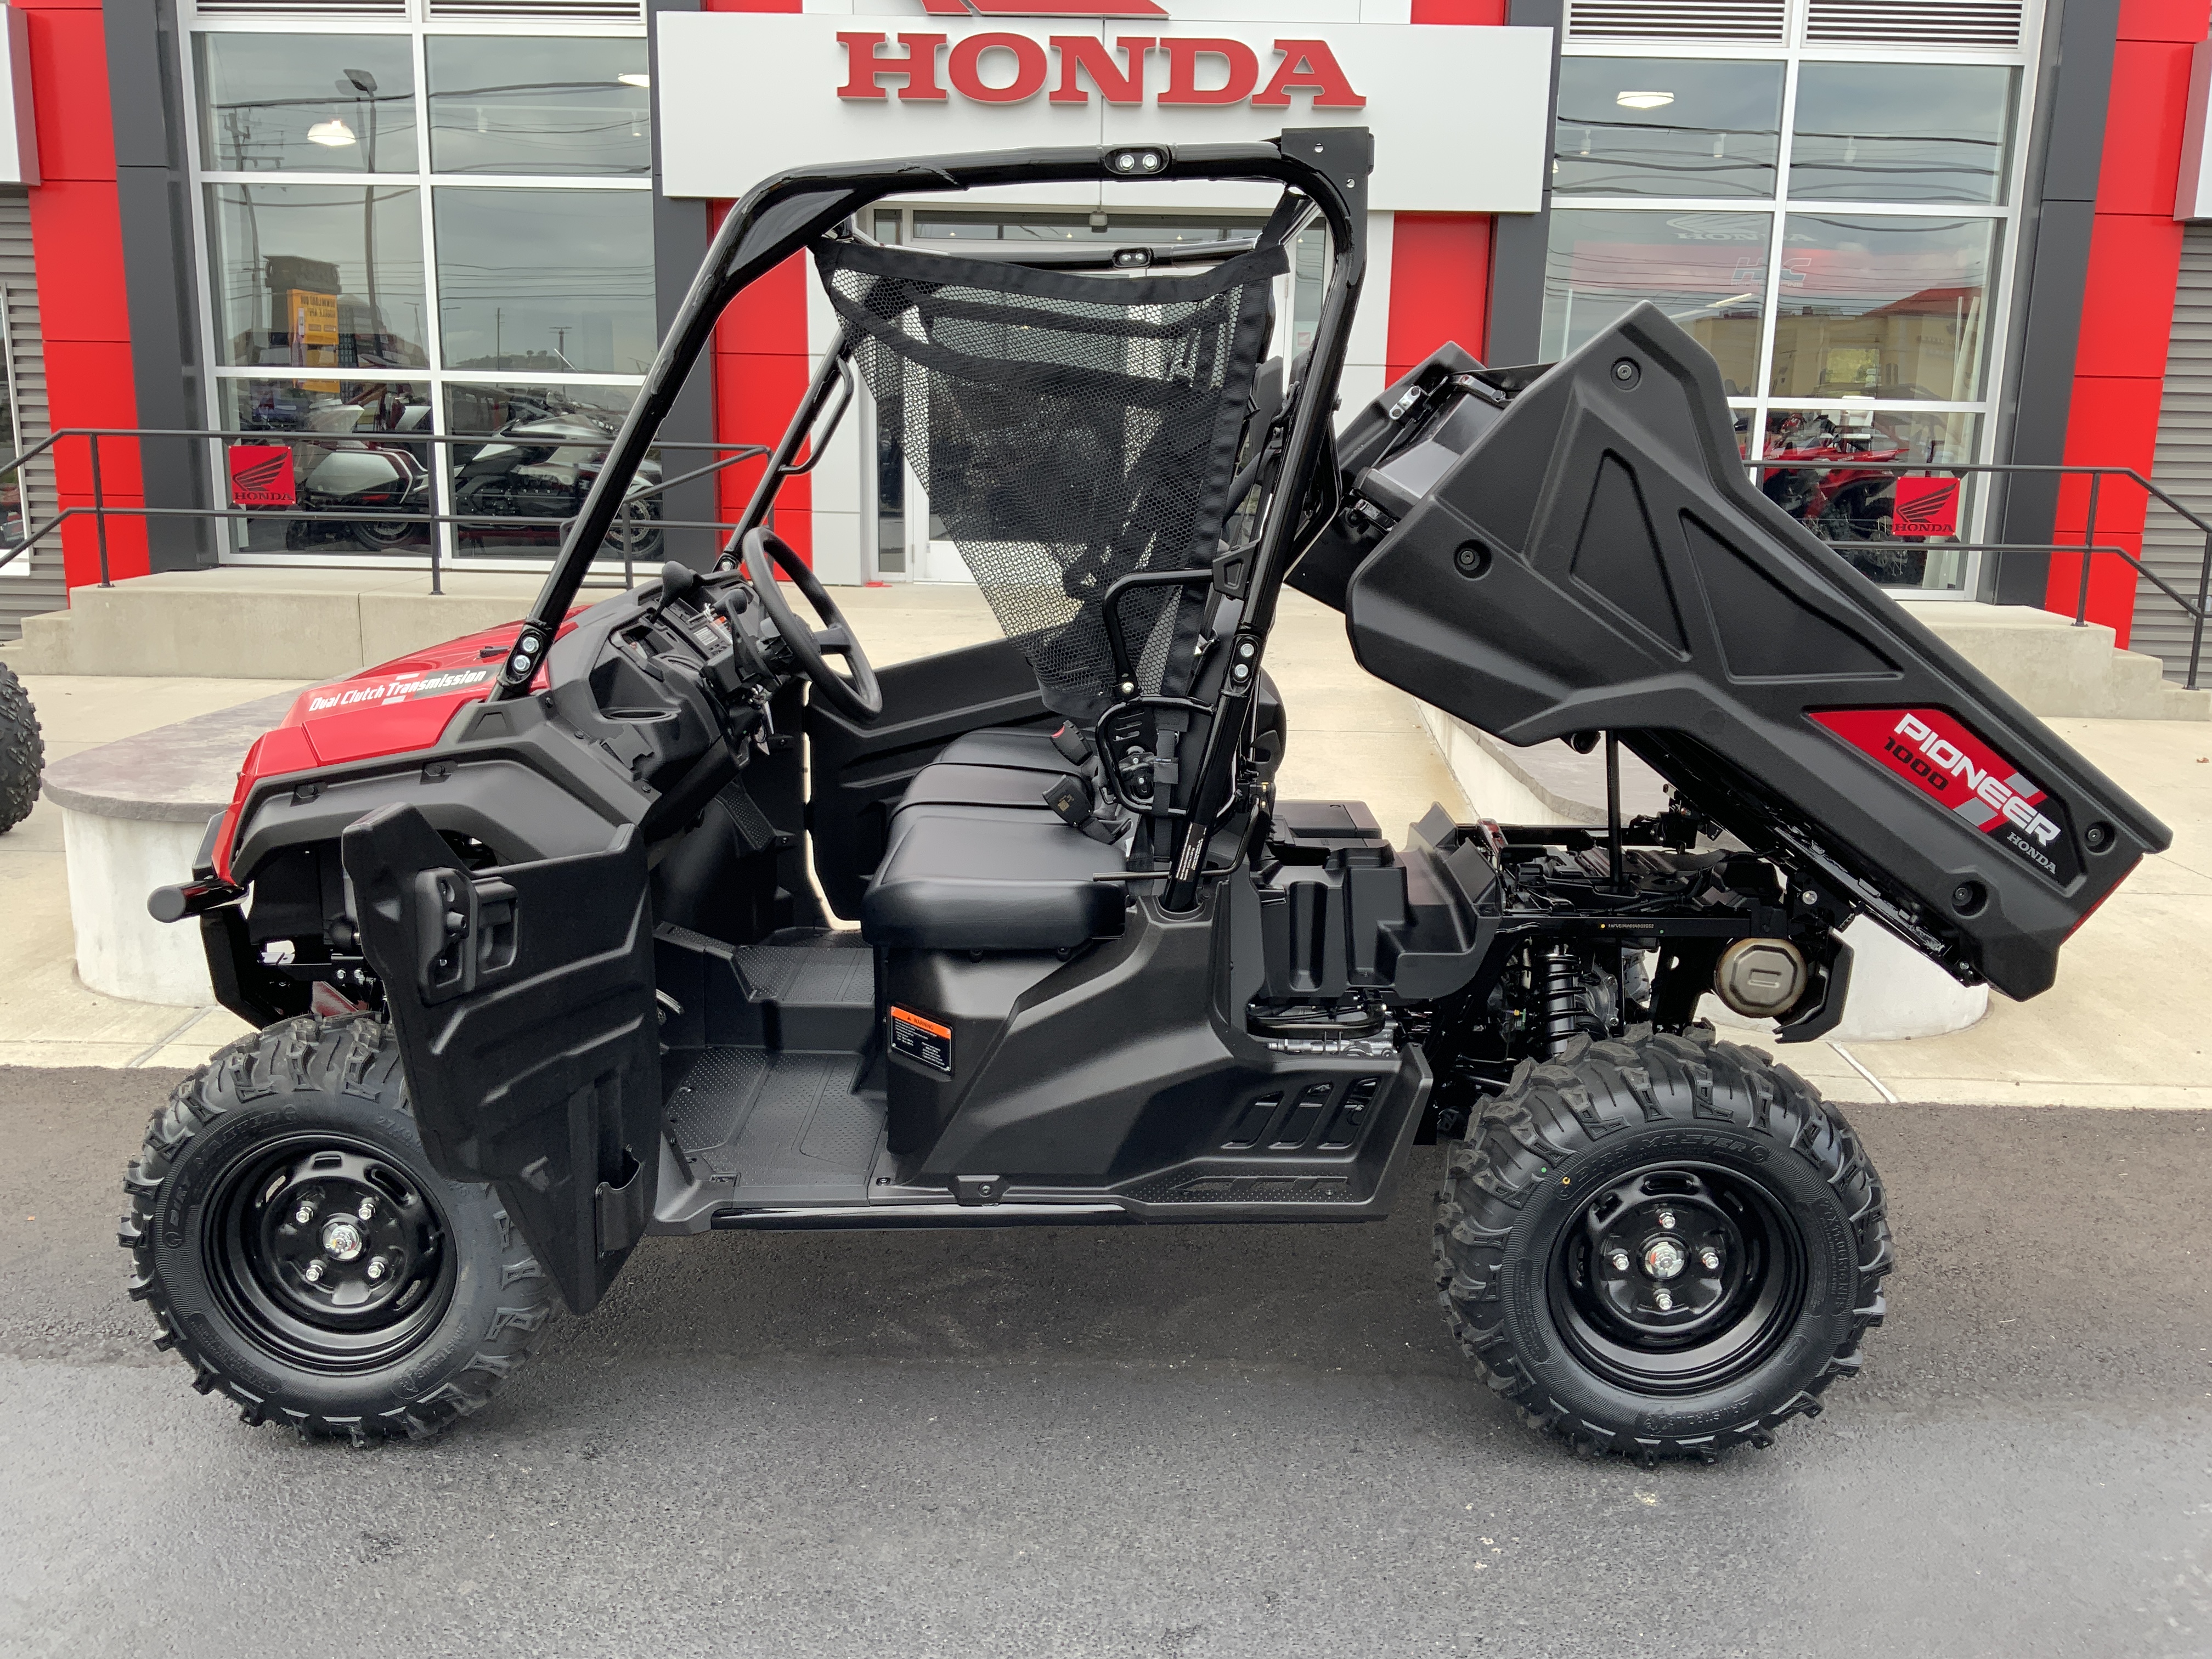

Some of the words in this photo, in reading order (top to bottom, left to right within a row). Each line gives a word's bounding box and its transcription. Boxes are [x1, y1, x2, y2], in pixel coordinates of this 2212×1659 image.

[837, 31, 1367, 108] HONDA
[1677, 233, 1818, 241] HONA
[1731, 257, 1812, 281] HC
[234, 492, 294, 500] HONDA
[1894, 523, 1954, 532] HONDA
[309, 692, 341, 712] Dual
[341, 685, 385, 706] Clutch
[387, 670, 487, 697] Transmission
[1883, 736, 1949, 791] 1000
[1894, 713, 2062, 847] PIONEER
[2007, 832, 2057, 874] HONDA
[913, 1017, 934, 1030] WARNING
[1639, 1134, 1747, 1152] MASTER
